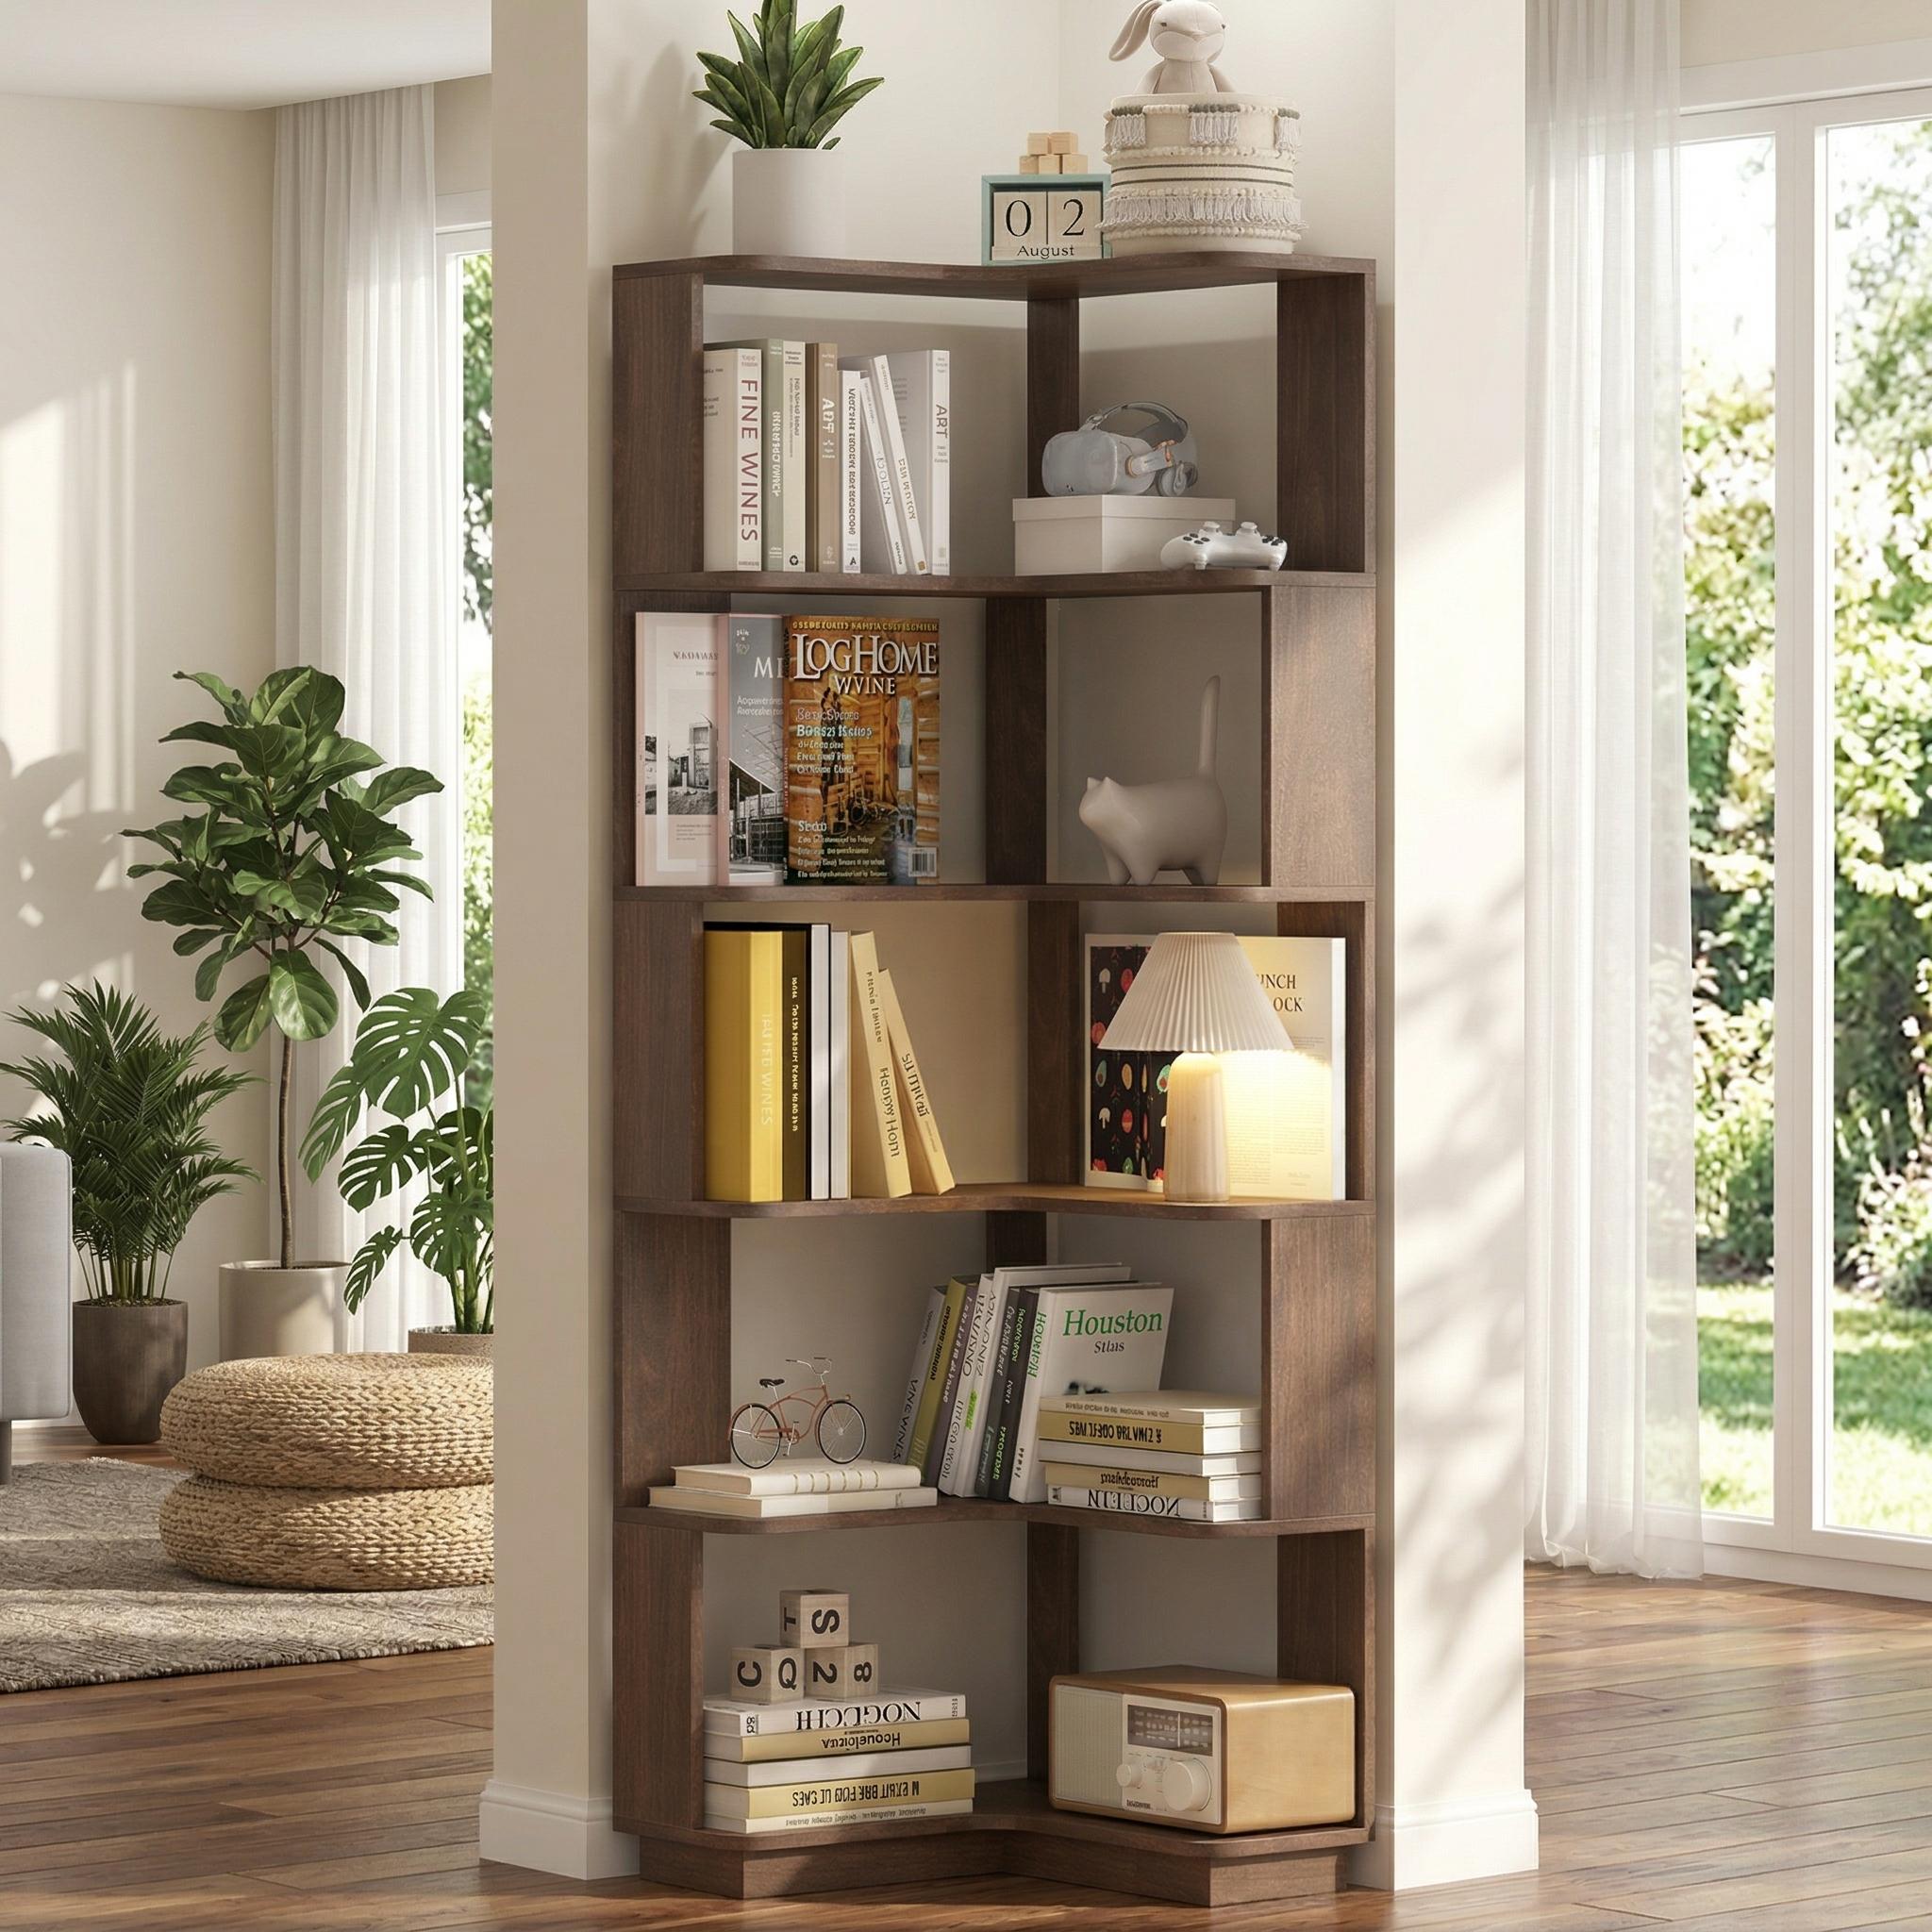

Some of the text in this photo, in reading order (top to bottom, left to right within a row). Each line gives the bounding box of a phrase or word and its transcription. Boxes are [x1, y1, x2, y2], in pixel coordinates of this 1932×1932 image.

[1006, 198, 1085, 237] 0 2
[1017, 245, 1074, 259] August
[741, 379, 758, 440] FINE
[935, 404, 948, 439] ART
[741, 452, 758, 541] WINES
[761, 1072, 774, 1125] WINES
[1062, 1309, 1163, 1336] Houston
[784, 1607, 796, 1632] T
[811, 1609, 841, 1635] S
[737, 1661, 762, 1688] C
[778, 1657, 797, 1690] Q
[853, 1661, 873, 1683] 8
